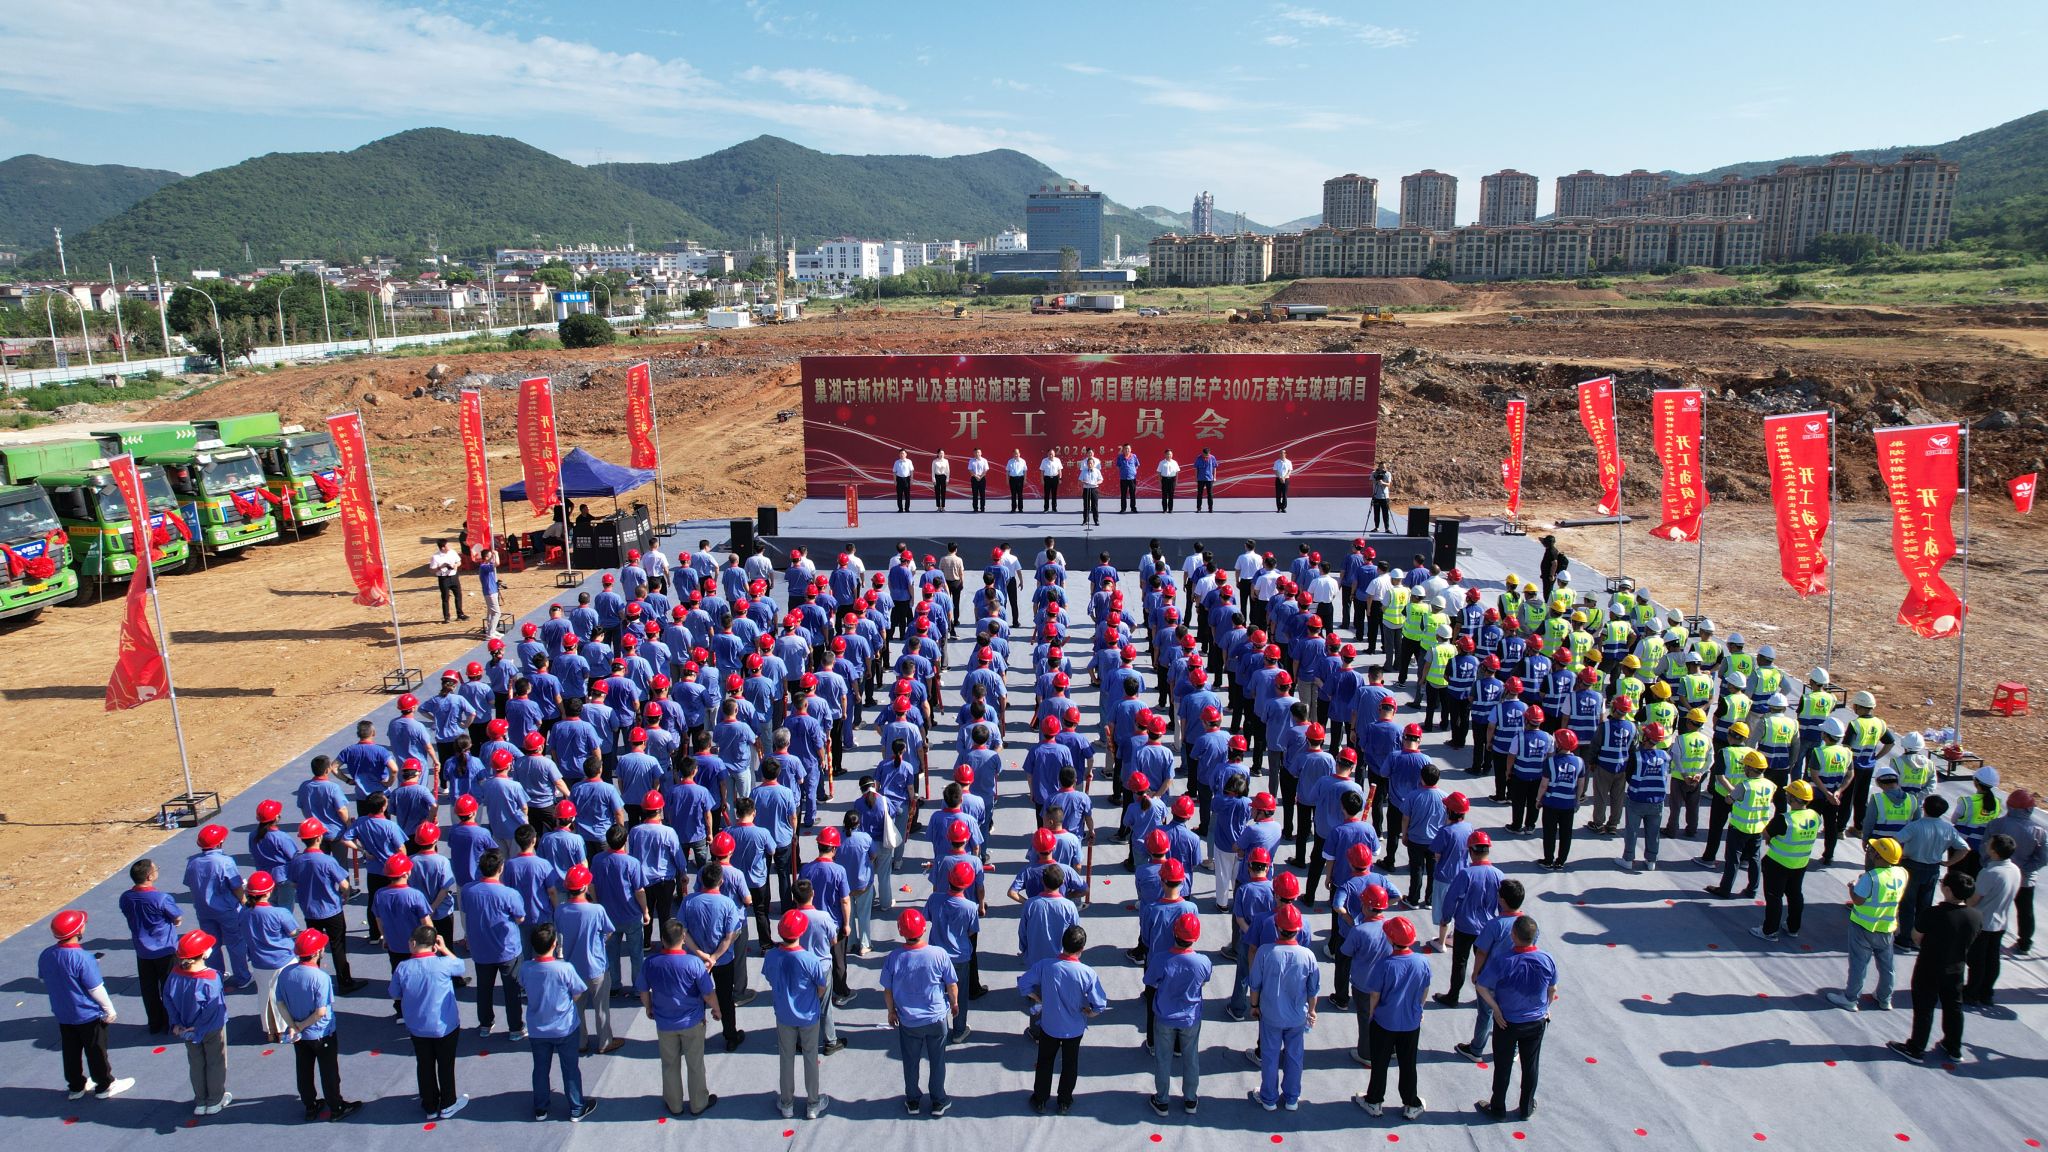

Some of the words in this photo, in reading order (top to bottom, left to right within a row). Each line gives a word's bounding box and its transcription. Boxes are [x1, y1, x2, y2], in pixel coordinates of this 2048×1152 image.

[950, 407, 1230, 440] 开工动员会
